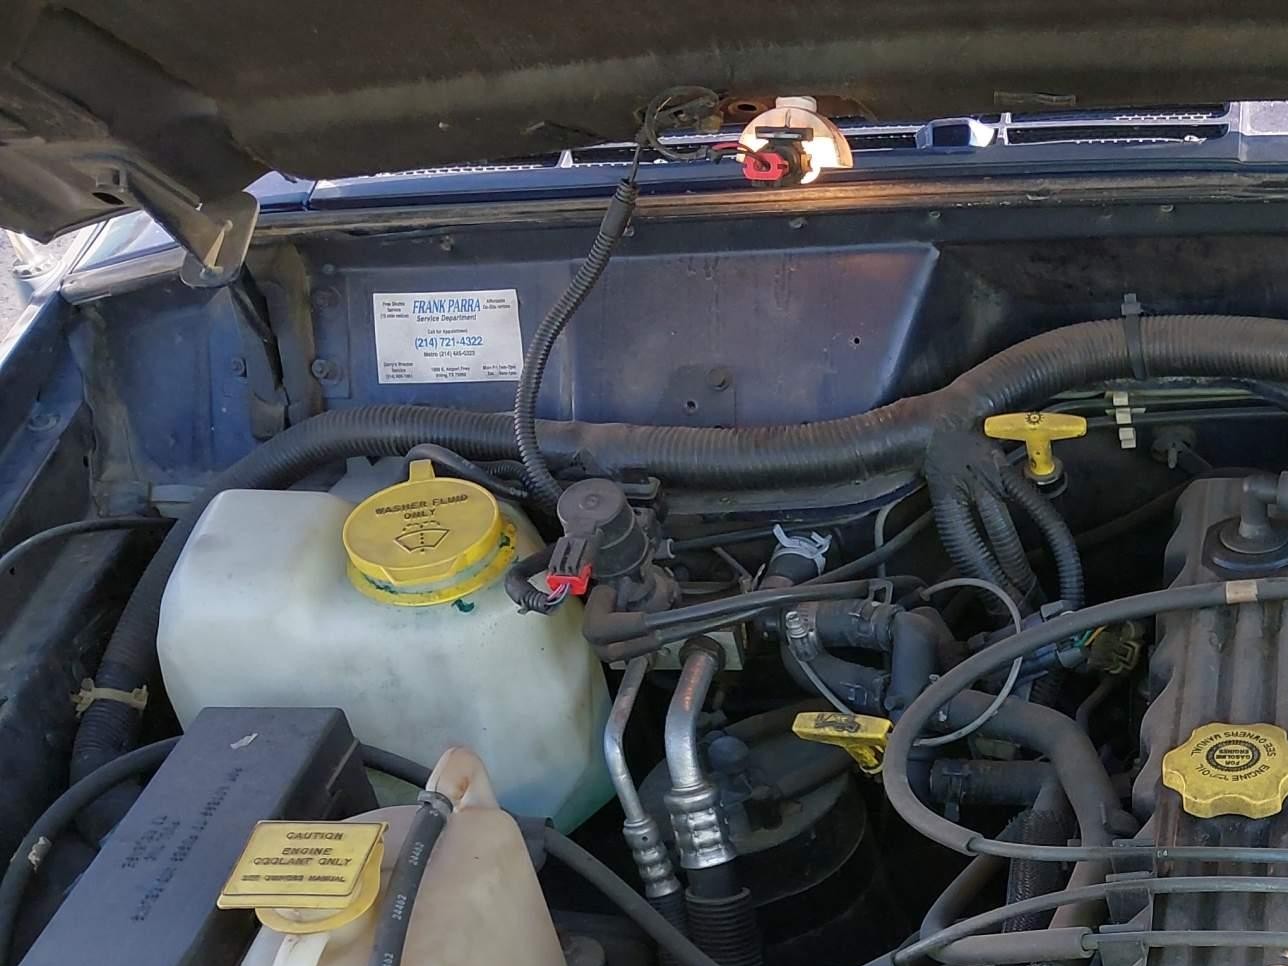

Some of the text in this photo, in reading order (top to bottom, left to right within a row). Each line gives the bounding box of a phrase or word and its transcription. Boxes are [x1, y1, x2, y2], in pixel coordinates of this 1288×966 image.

[412, 299, 446, 314] FRANK
[447, 298, 481, 313] PARRA
[416, 314, 477, 323] Service Department
[415, 336, 483, 350] (214) 721-4322
[375, 494, 468, 515] WASHER FLUID
[403, 508, 437, 520] ONLY
[1190, 731, 1277, 758] SEE OWNERS MANUAL
[1195, 763, 1270, 782] ENGINE OIL
[286, 832, 344, 840] CAUTION
[281, 847, 334, 856] ENGINE
[253, 857, 353, 866] COOLANT ONLY
